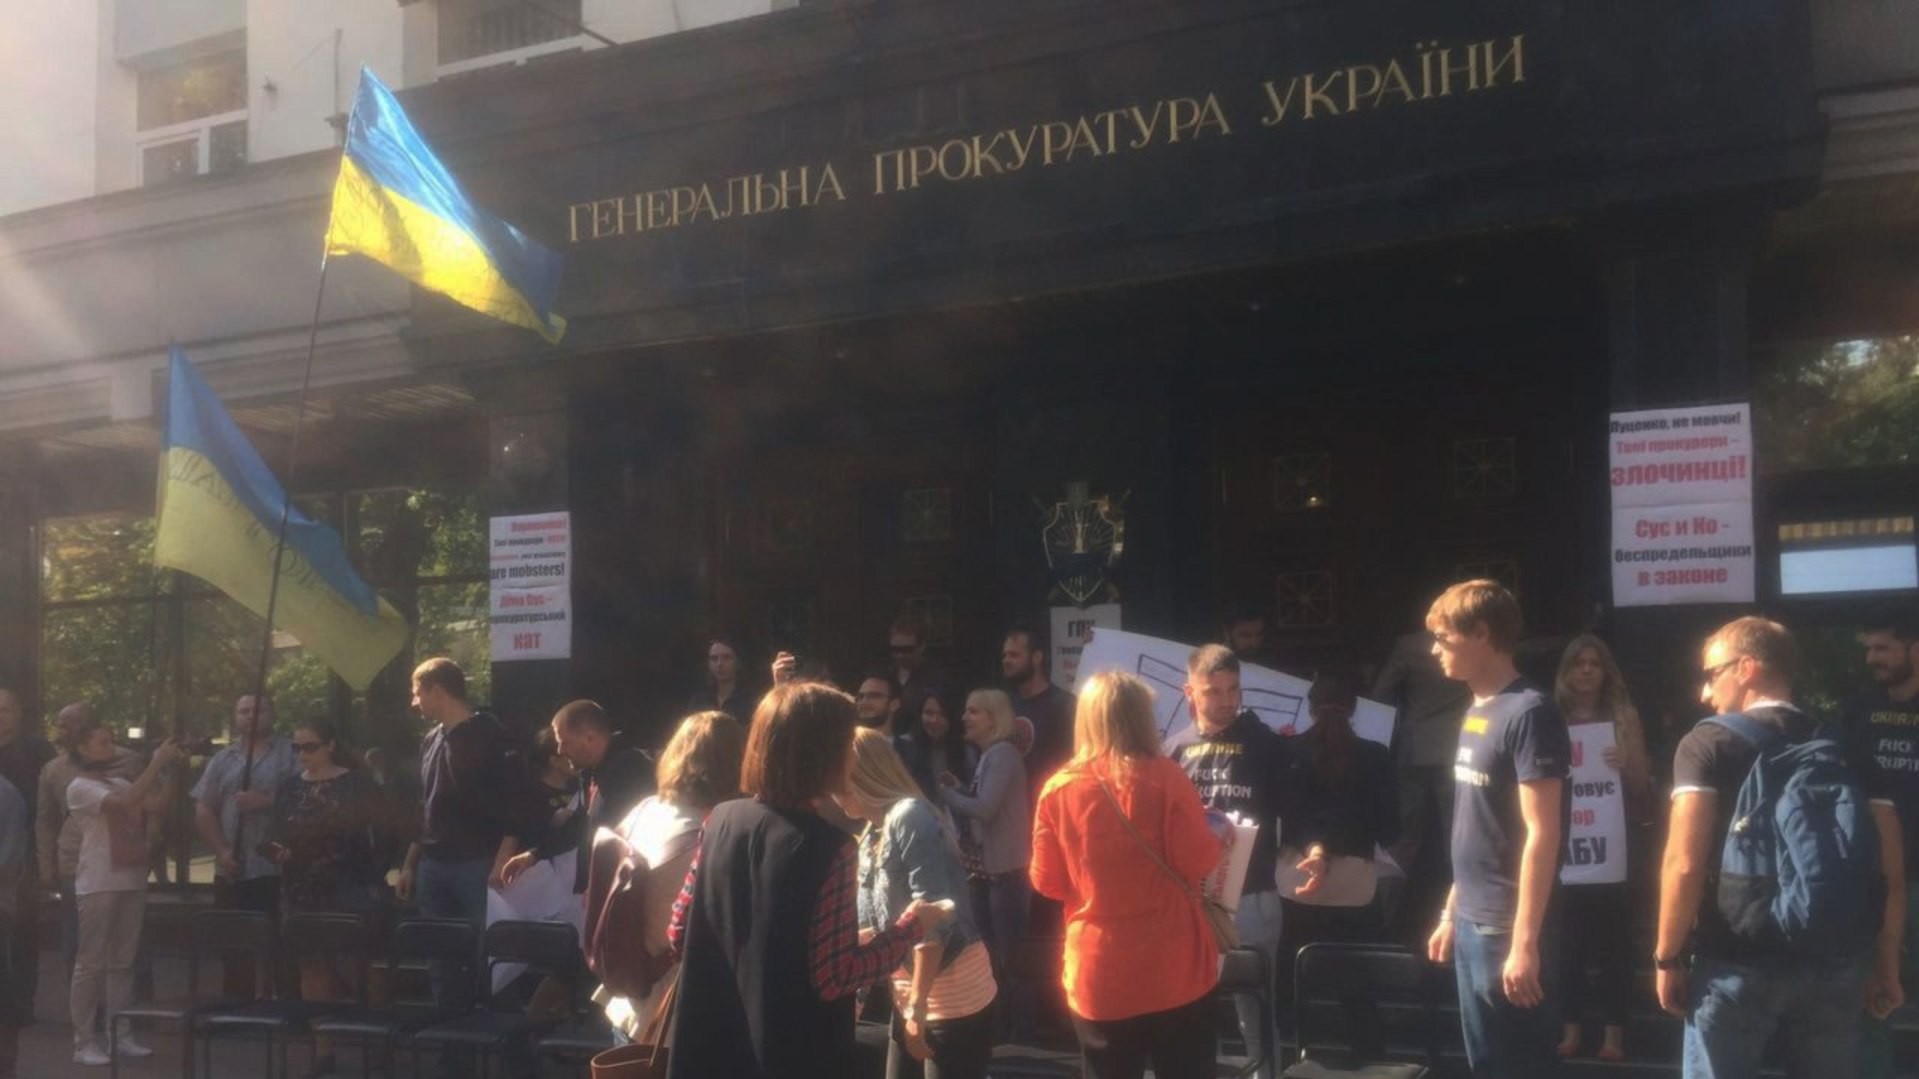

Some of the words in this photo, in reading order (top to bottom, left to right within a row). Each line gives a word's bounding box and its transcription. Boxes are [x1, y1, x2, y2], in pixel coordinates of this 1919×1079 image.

[568, 162, 846, 243] ГЕНЕРАЛЬНА
[873, 91, 1231, 195] ПРОКУРАТУРА
[1261, 34, 1527, 127] УКРАЇНИ
[1611, 455, 1747, 487] ЗЛОЧИНЦІ!
[1635, 518, 1670, 540] Сус
[1675, 519, 1688, 536] и
[1654, 568, 1728, 586] законе
[1573, 781, 1615, 798] овує
[1573, 808, 1595, 827] ор
